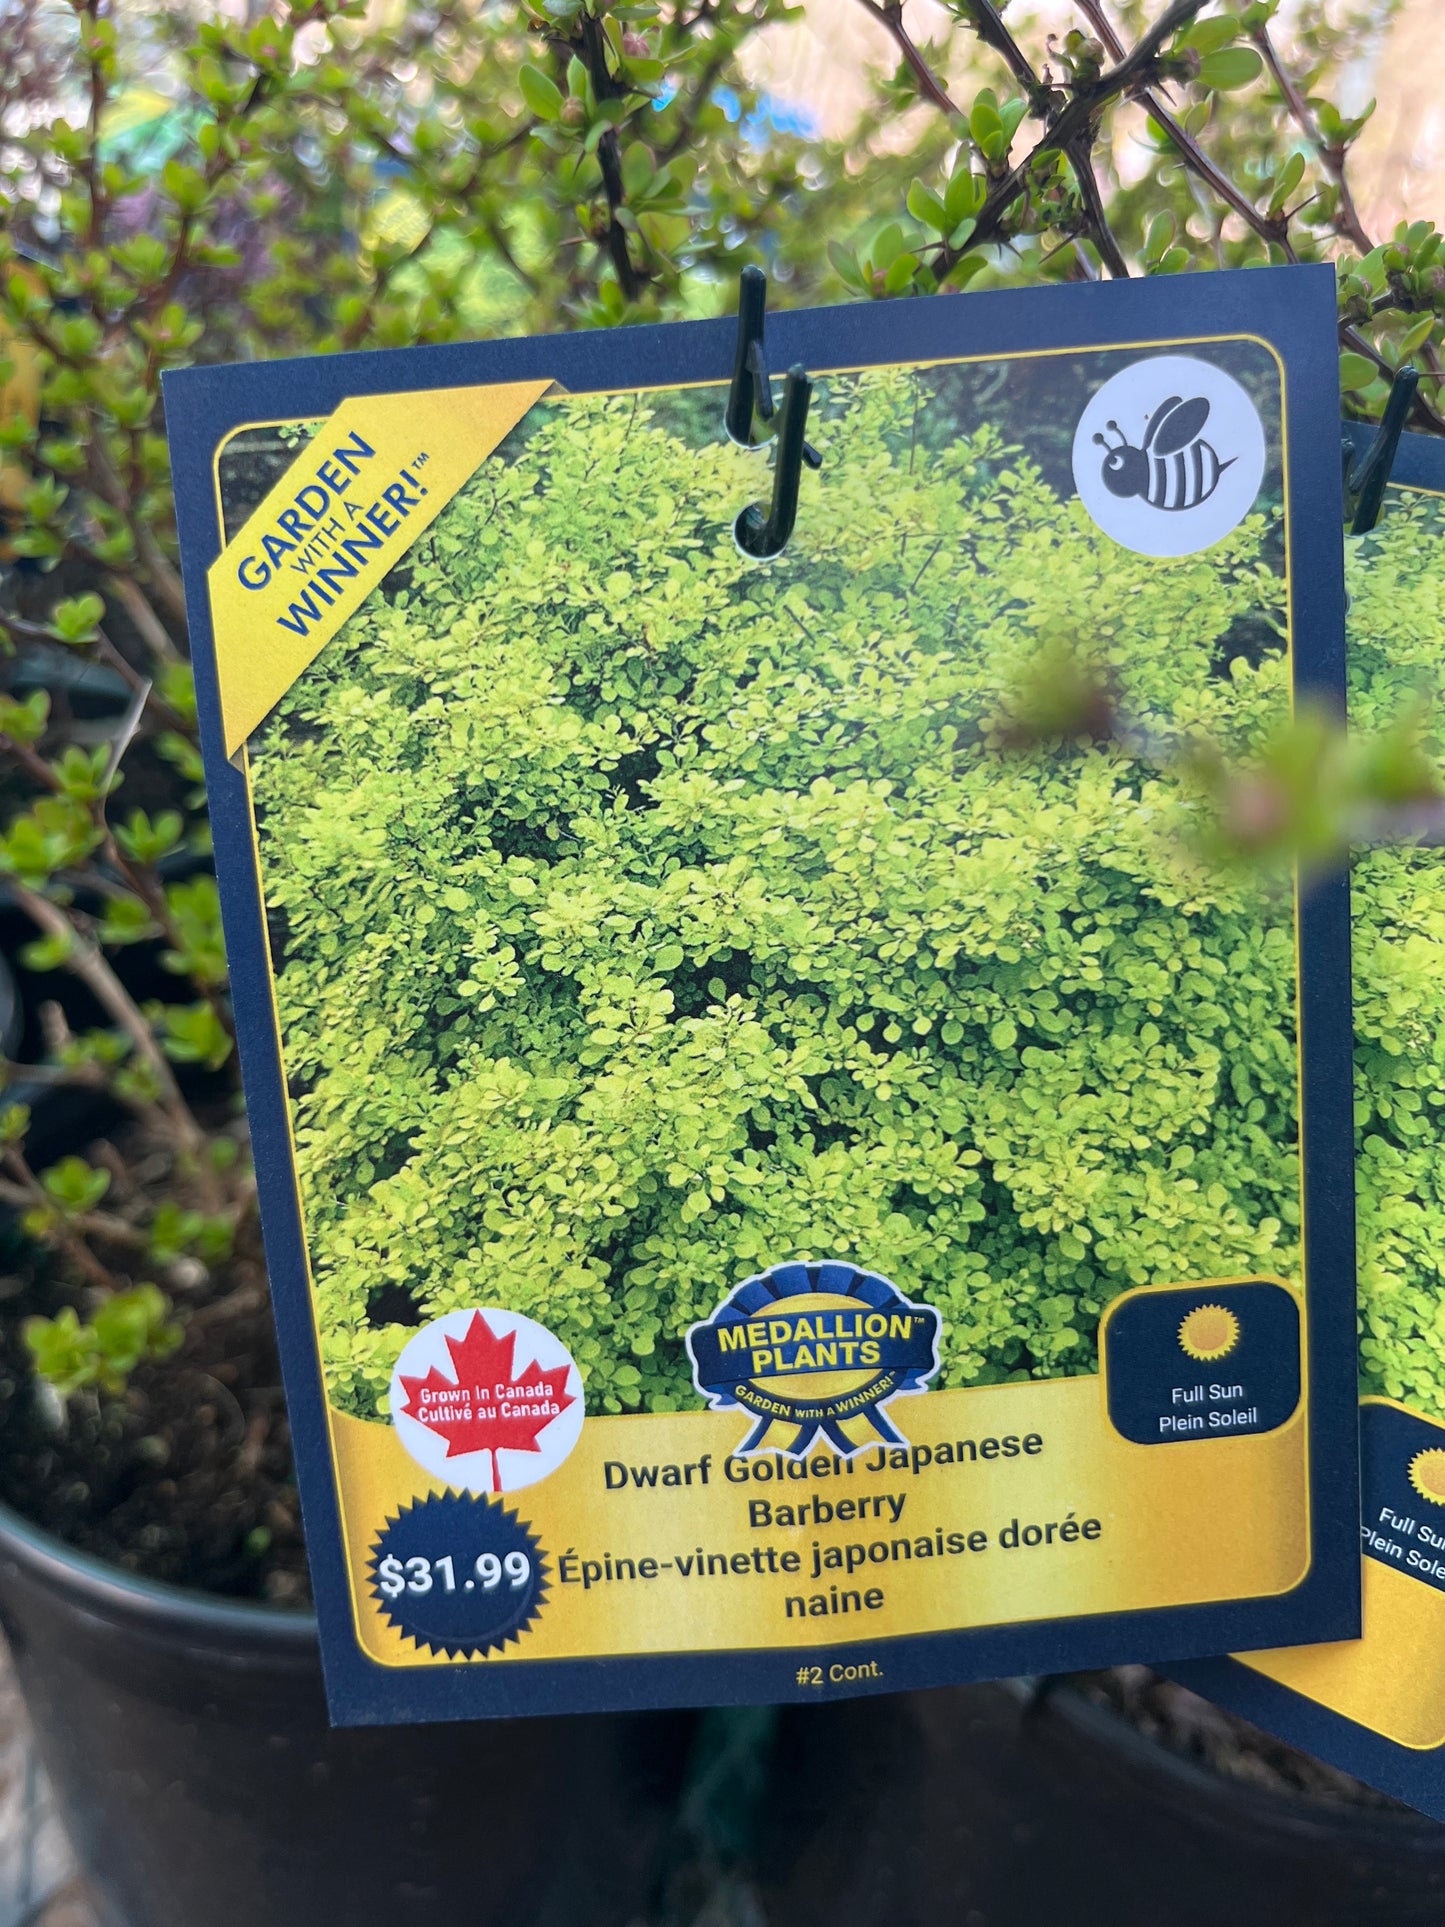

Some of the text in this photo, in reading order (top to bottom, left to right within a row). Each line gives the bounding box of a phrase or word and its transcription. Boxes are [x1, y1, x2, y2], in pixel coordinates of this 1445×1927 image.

[237, 431, 376, 592] GARDEN
[290, 501, 363, 576] WITH A
[752, 1340, 881, 1374] PLANTS
[420, 1381, 554, 1403] Grown In Canada
[735, 1384, 791, 1417] GARDEN
[795, 1409, 824, 1418] WITH
[826, 1406, 836, 1417] A
[1171, 1384, 1243, 1404] Full Sun
[418, 1401, 560, 1423] Cultivé au Canada
[1159, 1407, 1257, 1432] Plein Soleil
[603, 1455, 712, 1490] Dwarf
[865, 1432, 1044, 1474] Japanese
[748, 1493, 907, 1528] Barberry
[1379, 1507, 1415, 1535] Full
[558, 1511, 1102, 1590] Épine-vinette japonaise dorée
[378, 1551, 532, 1600] $31.99
[784, 1583, 885, 1618] naine
[796, 1661, 884, 1684] #2 Cont.
